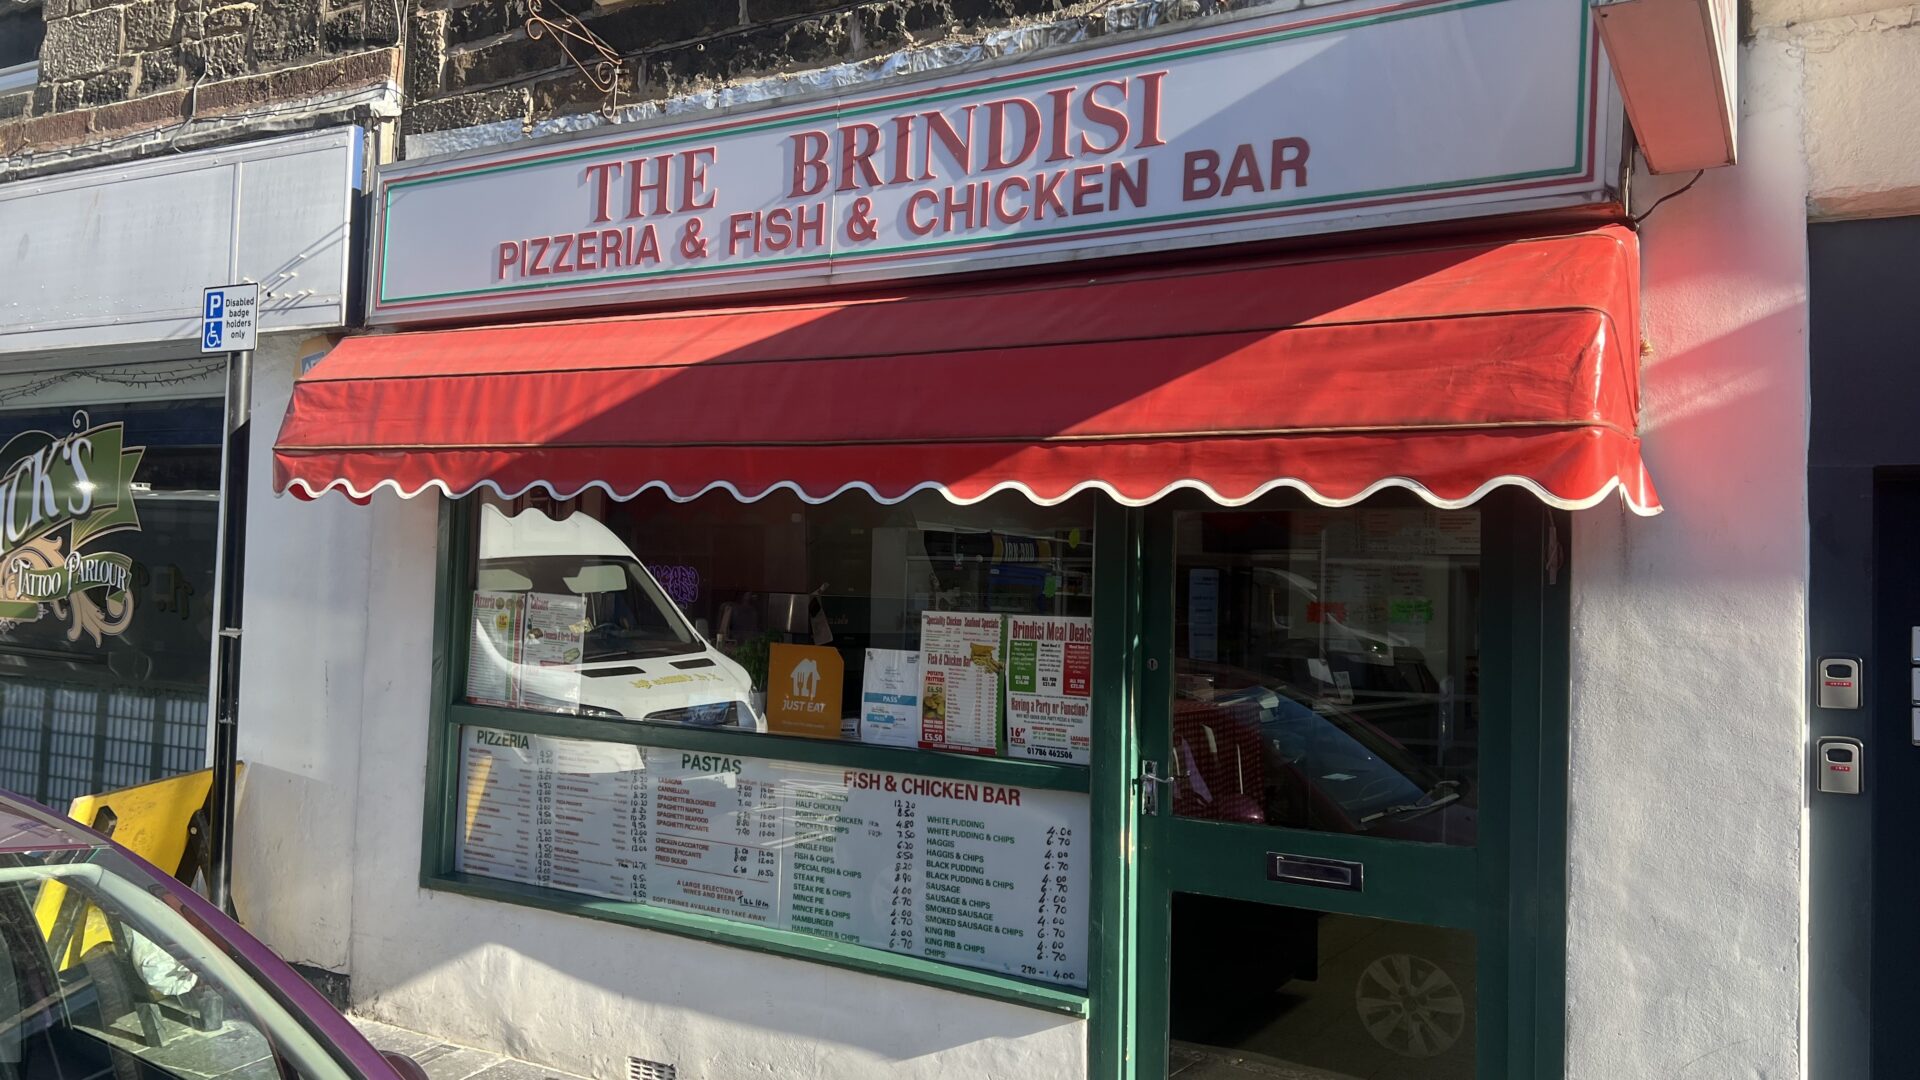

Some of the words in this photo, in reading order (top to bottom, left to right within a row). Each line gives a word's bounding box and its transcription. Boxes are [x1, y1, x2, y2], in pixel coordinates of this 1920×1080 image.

[586, 146, 718, 223] THE
[788, 69, 1169, 198] BRINDISI
[499, 224, 661, 280] PIZZERIA
[680, 217, 707, 258] &
[728, 202, 825, 256] FISH
[846, 197, 878, 242] &
[906, 158, 1149, 235] CHICKEN
[1183, 136, 1311, 201] BAR
[226, 296, 254, 307] Disabled
[229, 309, 249, 318] badge
[226, 320, 251, 328] holders
[231, 330, 245, 339] only
[1013, 620, 1044, 640] Brindisi
[1047, 622, 1067, 641] Meal
[1069, 623, 1092, 642] Deals
[928, 653, 937, 664] Fish
[944, 655, 962, 666] Chicken
[782, 700, 805, 711] JUST
[807, 702, 826, 713] EAT
[1011, 697, 1029, 713] Having
[1031, 702, 1034, 712] a
[1036, 699, 1050, 715] Party
[1053, 704, 1059, 714] or
[1061, 701, 1089, 717] Function?
[477, 730, 529, 750] PIZZERIA
[925, 733, 942, 741] £5.50
[1027, 747, 1047, 756] 01786
[1049, 750, 1073, 759] 462506
[682, 754, 742, 775] PASTAS
[658, 786, 689, 794] CANNELLONI
[843, 771, 881, 790] FISH
[884, 775, 897, 792] &
[901, 778, 978, 802] CHICKEN
[983, 786, 1021, 806] BAR
[657, 803, 685, 811] SPAGHETTI
[686, 798, 716, 807] BOLOGNESE
[813, 802, 841, 812] CHICKEN
[657, 811, 684, 819] SPAGHETTI
[685, 815, 708, 823] SEAFOOD
[835, 816, 863, 825] CHICKEN
[927, 816, 951, 825] WHITE
[951, 819, 985, 829] PUDDING
[685, 824, 709, 832] PICCANTE
[830, 826, 849, 834] CHIPS
[895, 820, 914, 829] 4.80
[927, 827, 951, 837] WHITE
[951, 830, 984, 841] PUDDING
[993, 836, 1015, 844] CHIPS
[656, 838, 677, 846] CHICKEN
[897, 841, 914, 850] 6.20
[927, 838, 955, 848] HAGGIS
[656, 846, 677, 854] CHICKEN
[678, 850, 702, 859] PICCANTE
[794, 852, 808, 860] FISH
[815, 856, 835, 864] CHIPS
[926, 849, 954, 859] HAGGIS
[955, 852, 961, 860] &
[962, 854, 985, 863] CHIPS
[671, 857, 688, 865] SQUID
[926, 860, 949, 870] BLACK
[951, 863, 984, 874] PUDDING
[793, 863, 820, 872] SPECIAL
[821, 866, 835, 874] FISH
[843, 870, 862, 878] CHIPS
[793, 873, 814, 881] STEAK
[926, 871, 949, 881] BLACK
[950, 874, 984, 886] PUDDING
[985, 879, 991, 887] &
[992, 880, 1015, 890] CHIPS
[682, 881, 700, 889] LARGE
[702, 884, 733, 895] SELECTION
[793, 883, 814, 892] STEAK
[832, 890, 852, 898] CHIPS
[926, 882, 961, 893] SAUSAGE
[683, 888, 702, 896] WINES
[716, 894, 736, 902] BEERS
[792, 894, 814, 902] MINCE
[667, 899, 689, 908] DRINKS
[690, 903, 721, 913] AVAILABLE
[722, 907, 730, 915] TO
[891, 896, 912, 907] 6.70
[925, 894, 961, 905] SAUSAGE
[962, 898, 968, 906] &
[968, 899, 991, 909] CHIPS
[792, 904, 814, 912] MINCE
[831, 910, 851, 919] CHIPS
[925, 904, 957, 915] SMOKED
[957, 909, 994, 921] SAUSAGE
[792, 915, 834, 927] HAMBURGER
[890, 917, 913, 927] 6.70
[925, 915, 957, 927] SMOKED
[957, 920, 993, 932] SAUSAGE
[1002, 928, 1024, 937] CHIPS
[791, 925, 833, 937] HAMBURGER
[840, 934, 860, 943] CHIPS
[925, 926, 943, 936] KING
[944, 929, 956, 938] RIB
[925, 938, 943, 947] KING
[944, 940, 956, 949] RIB
[957, 942, 962, 950] &
[964, 944, 985, 954] CHIPS
[925, 948, 946, 958] CHIPS
